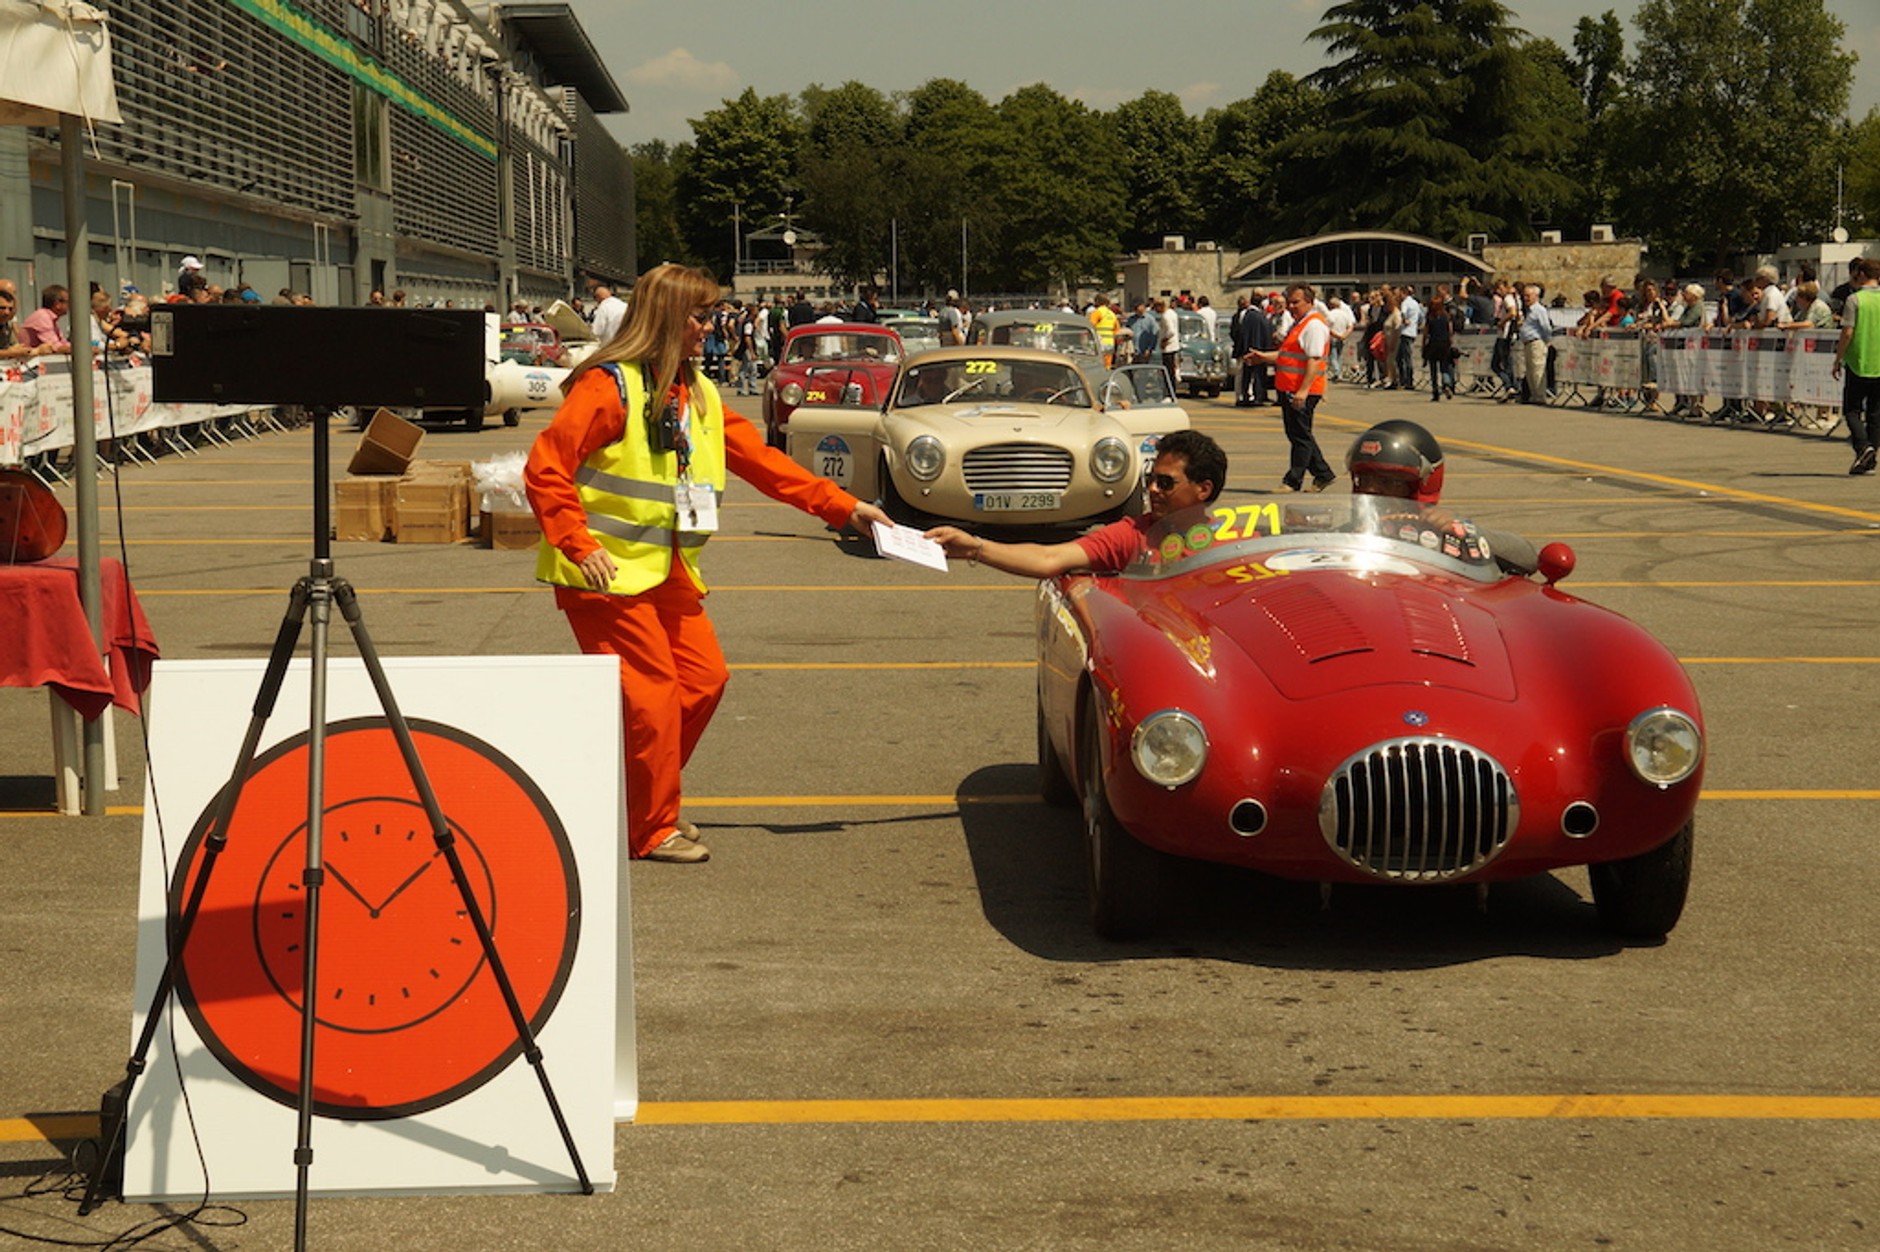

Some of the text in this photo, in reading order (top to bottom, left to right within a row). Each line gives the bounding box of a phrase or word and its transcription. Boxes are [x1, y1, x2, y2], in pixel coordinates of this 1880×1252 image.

[966, 361, 997, 374] 272
[528, 381, 547, 392] 305
[806, 391, 827, 401] 274
[823, 456, 844, 477] 272
[1021, 494, 1055, 508] 2299
[1213, 503, 1281, 541] 271
